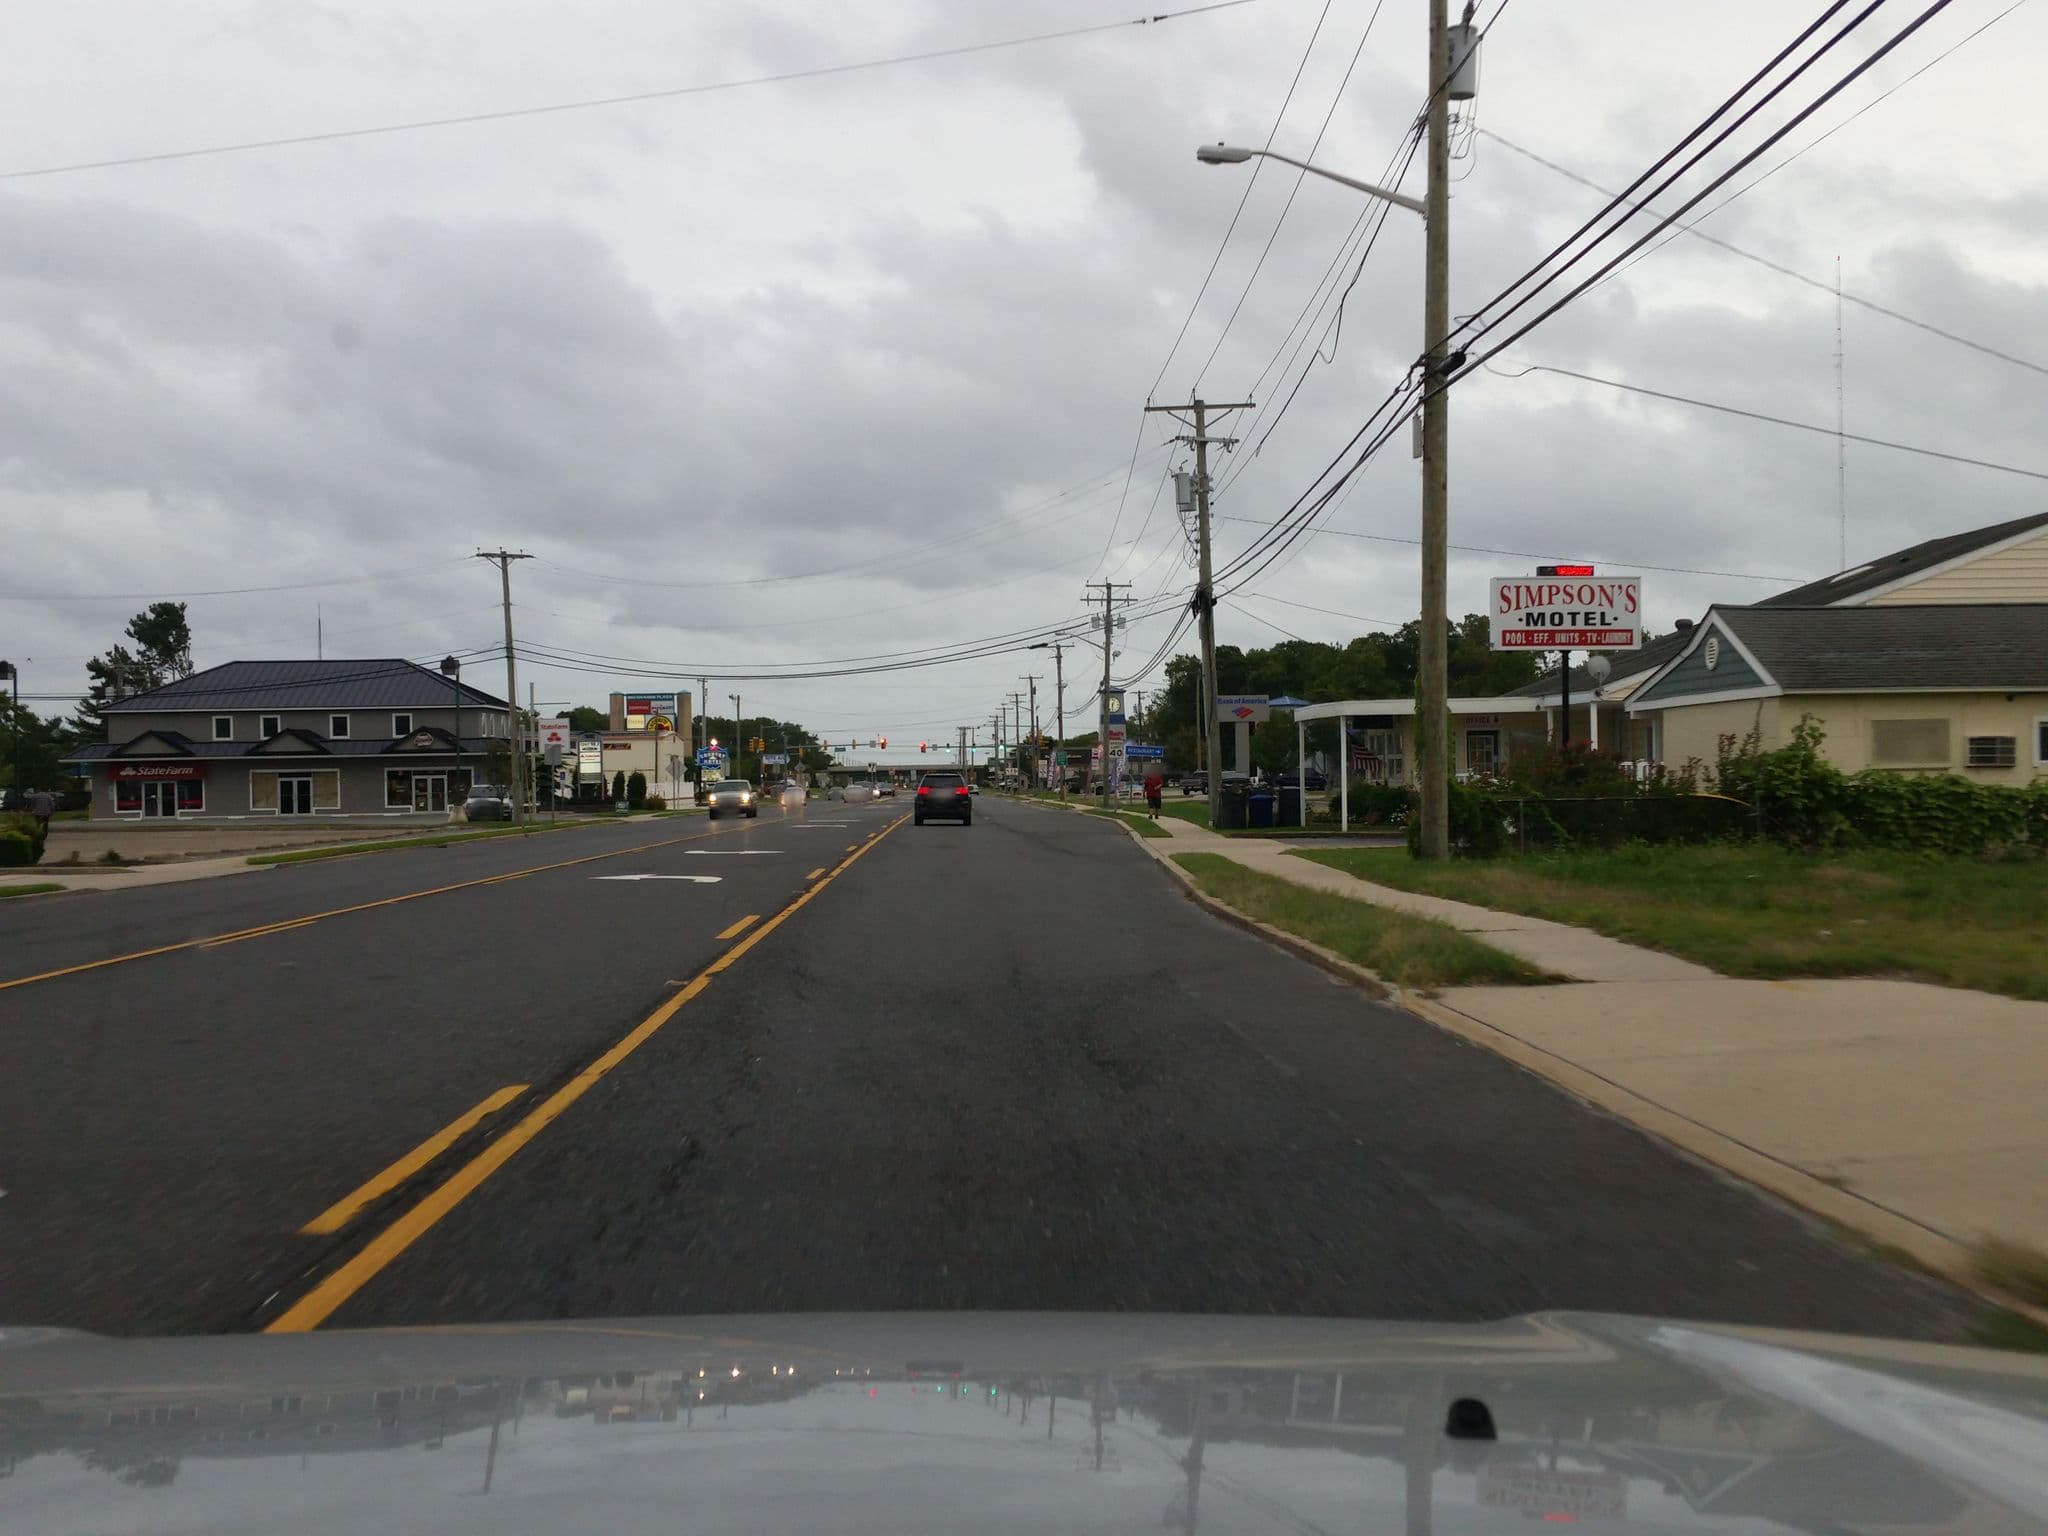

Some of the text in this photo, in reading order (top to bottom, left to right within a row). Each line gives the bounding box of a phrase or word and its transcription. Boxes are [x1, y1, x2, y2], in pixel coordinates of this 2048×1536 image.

[1500, 584, 1637, 614] SIMPSON'S
[1525, 612, 1612, 627] MOTEL
[1505, 632, 1527, 644] POOL
[1555, 632, 1579, 644] UNITS
[1587, 632, 1597, 644] TV
[1110, 749, 1123, 757] 40
